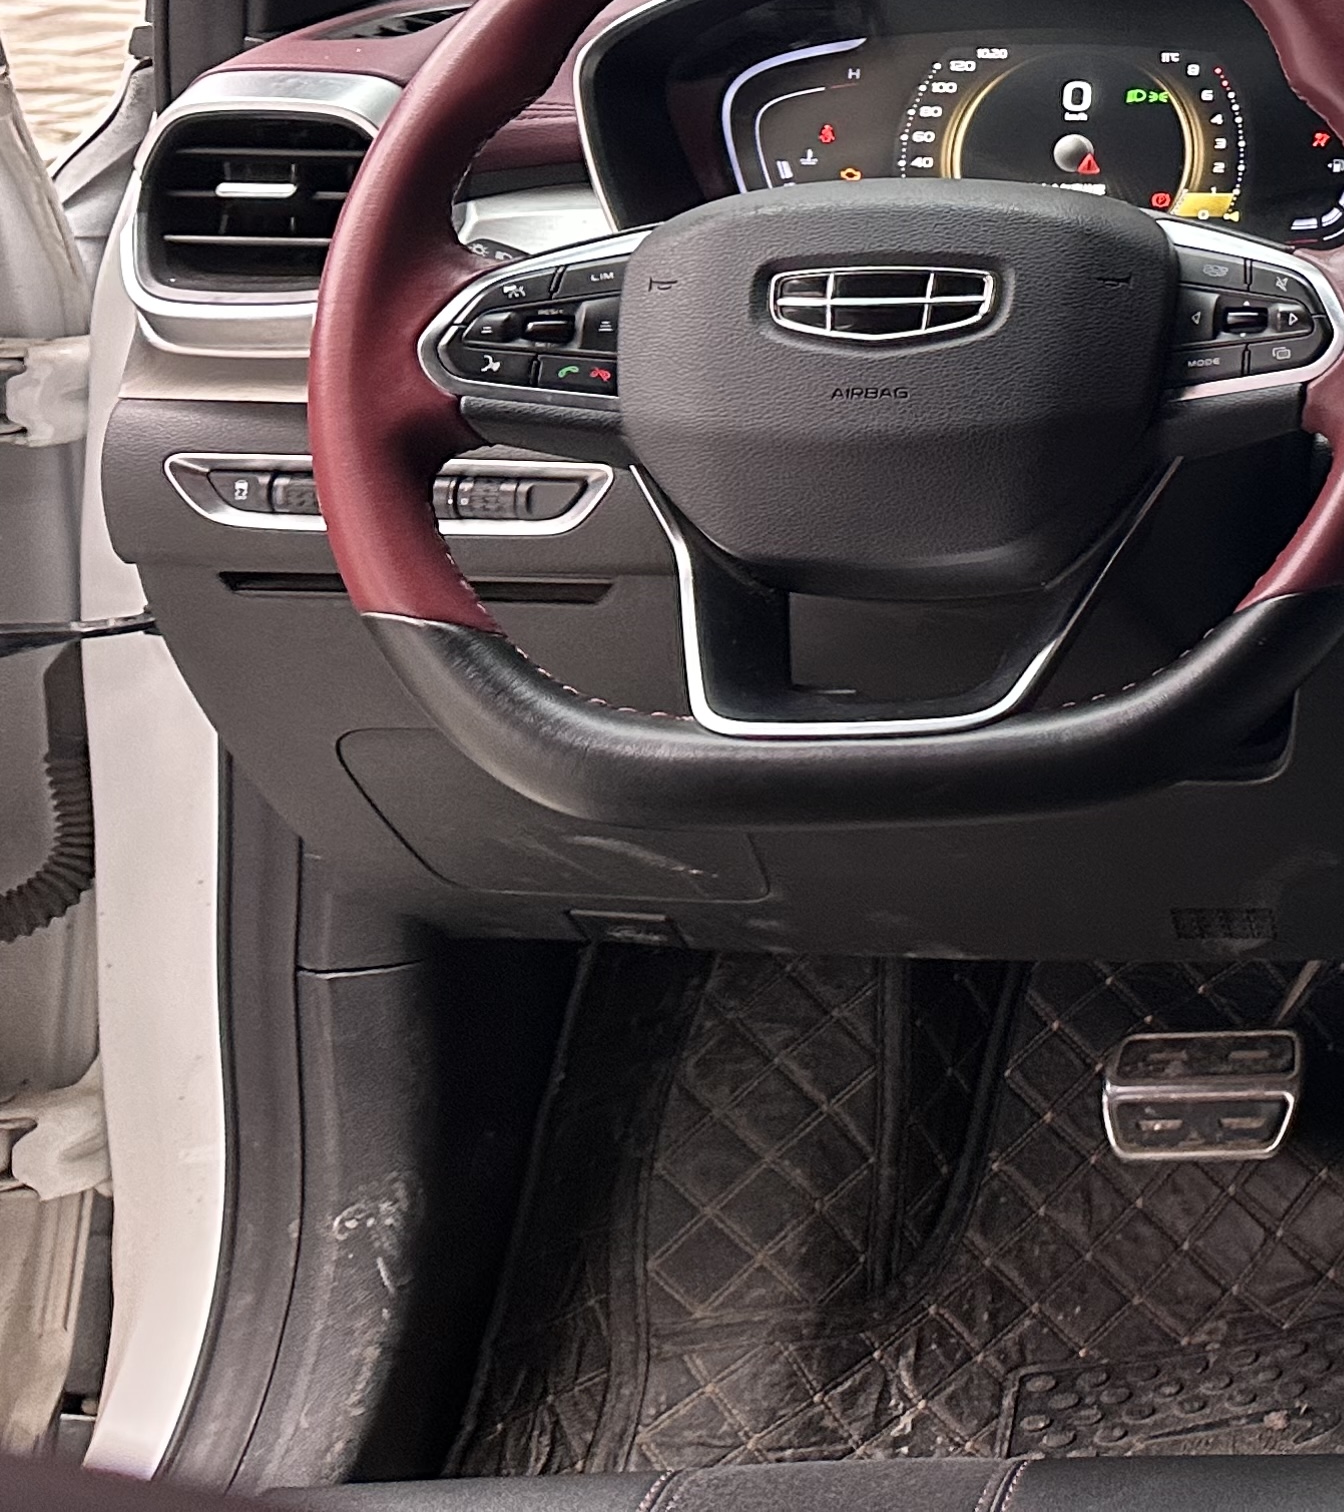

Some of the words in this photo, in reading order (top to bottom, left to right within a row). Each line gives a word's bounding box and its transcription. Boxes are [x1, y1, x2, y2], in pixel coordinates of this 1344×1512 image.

[949, 60, 976, 72] 120
[1187, 64, 1200, 76] 8
[848, 68, 861, 80] H
[931, 82, 957, 93] 100
[1062, 80, 1092, 112] 0
[1201, 90, 1214, 101] 6
[919, 106, 942, 118] 80
[1210, 114, 1224, 125] 4
[912, 131, 935, 142] 60
[1214, 138, 1227, 149] 3
[910, 157, 934, 168] 40
[1212, 162, 1225, 174] 2
[590, 271, 614, 281] LIM
[1188, 358, 1220, 368] MODE
[831, 387, 910, 400] AIRBAG
